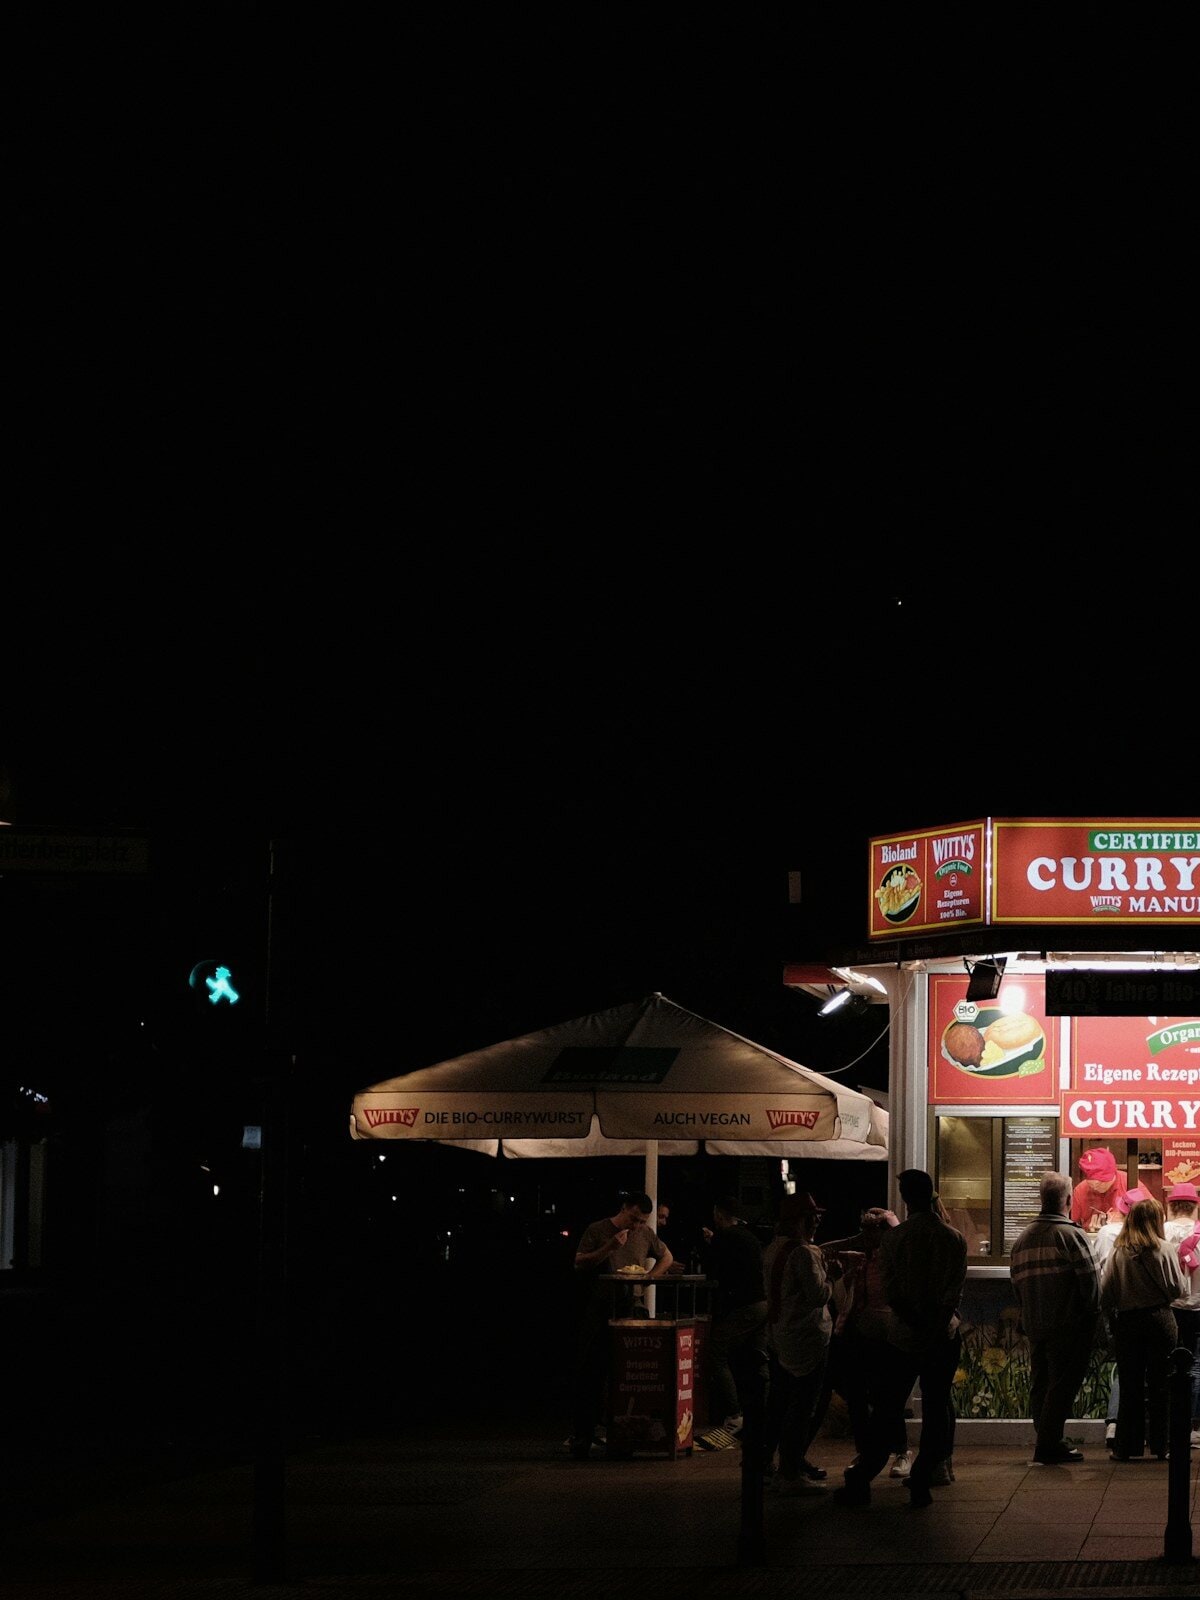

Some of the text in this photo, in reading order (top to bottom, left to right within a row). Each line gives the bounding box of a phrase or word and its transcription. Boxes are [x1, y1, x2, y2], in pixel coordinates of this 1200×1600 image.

[881, 841, 917, 864] Bioland
[932, 834, 975, 866] WITTY'S
[944, 889, 963, 899] Eigene
[1090, 895, 1122, 908] WITTY'S
[937, 898, 970, 908] Rezepturen
[1084, 1063, 1142, 1084] Eigene
[366, 1109, 585, 1126] WITTY'S DIE BIO-CURRYWURST
[653, 1110, 816, 1127] AUCH VEGAN WITTY'S
[1172, 1140, 1197, 1148] Leckere
